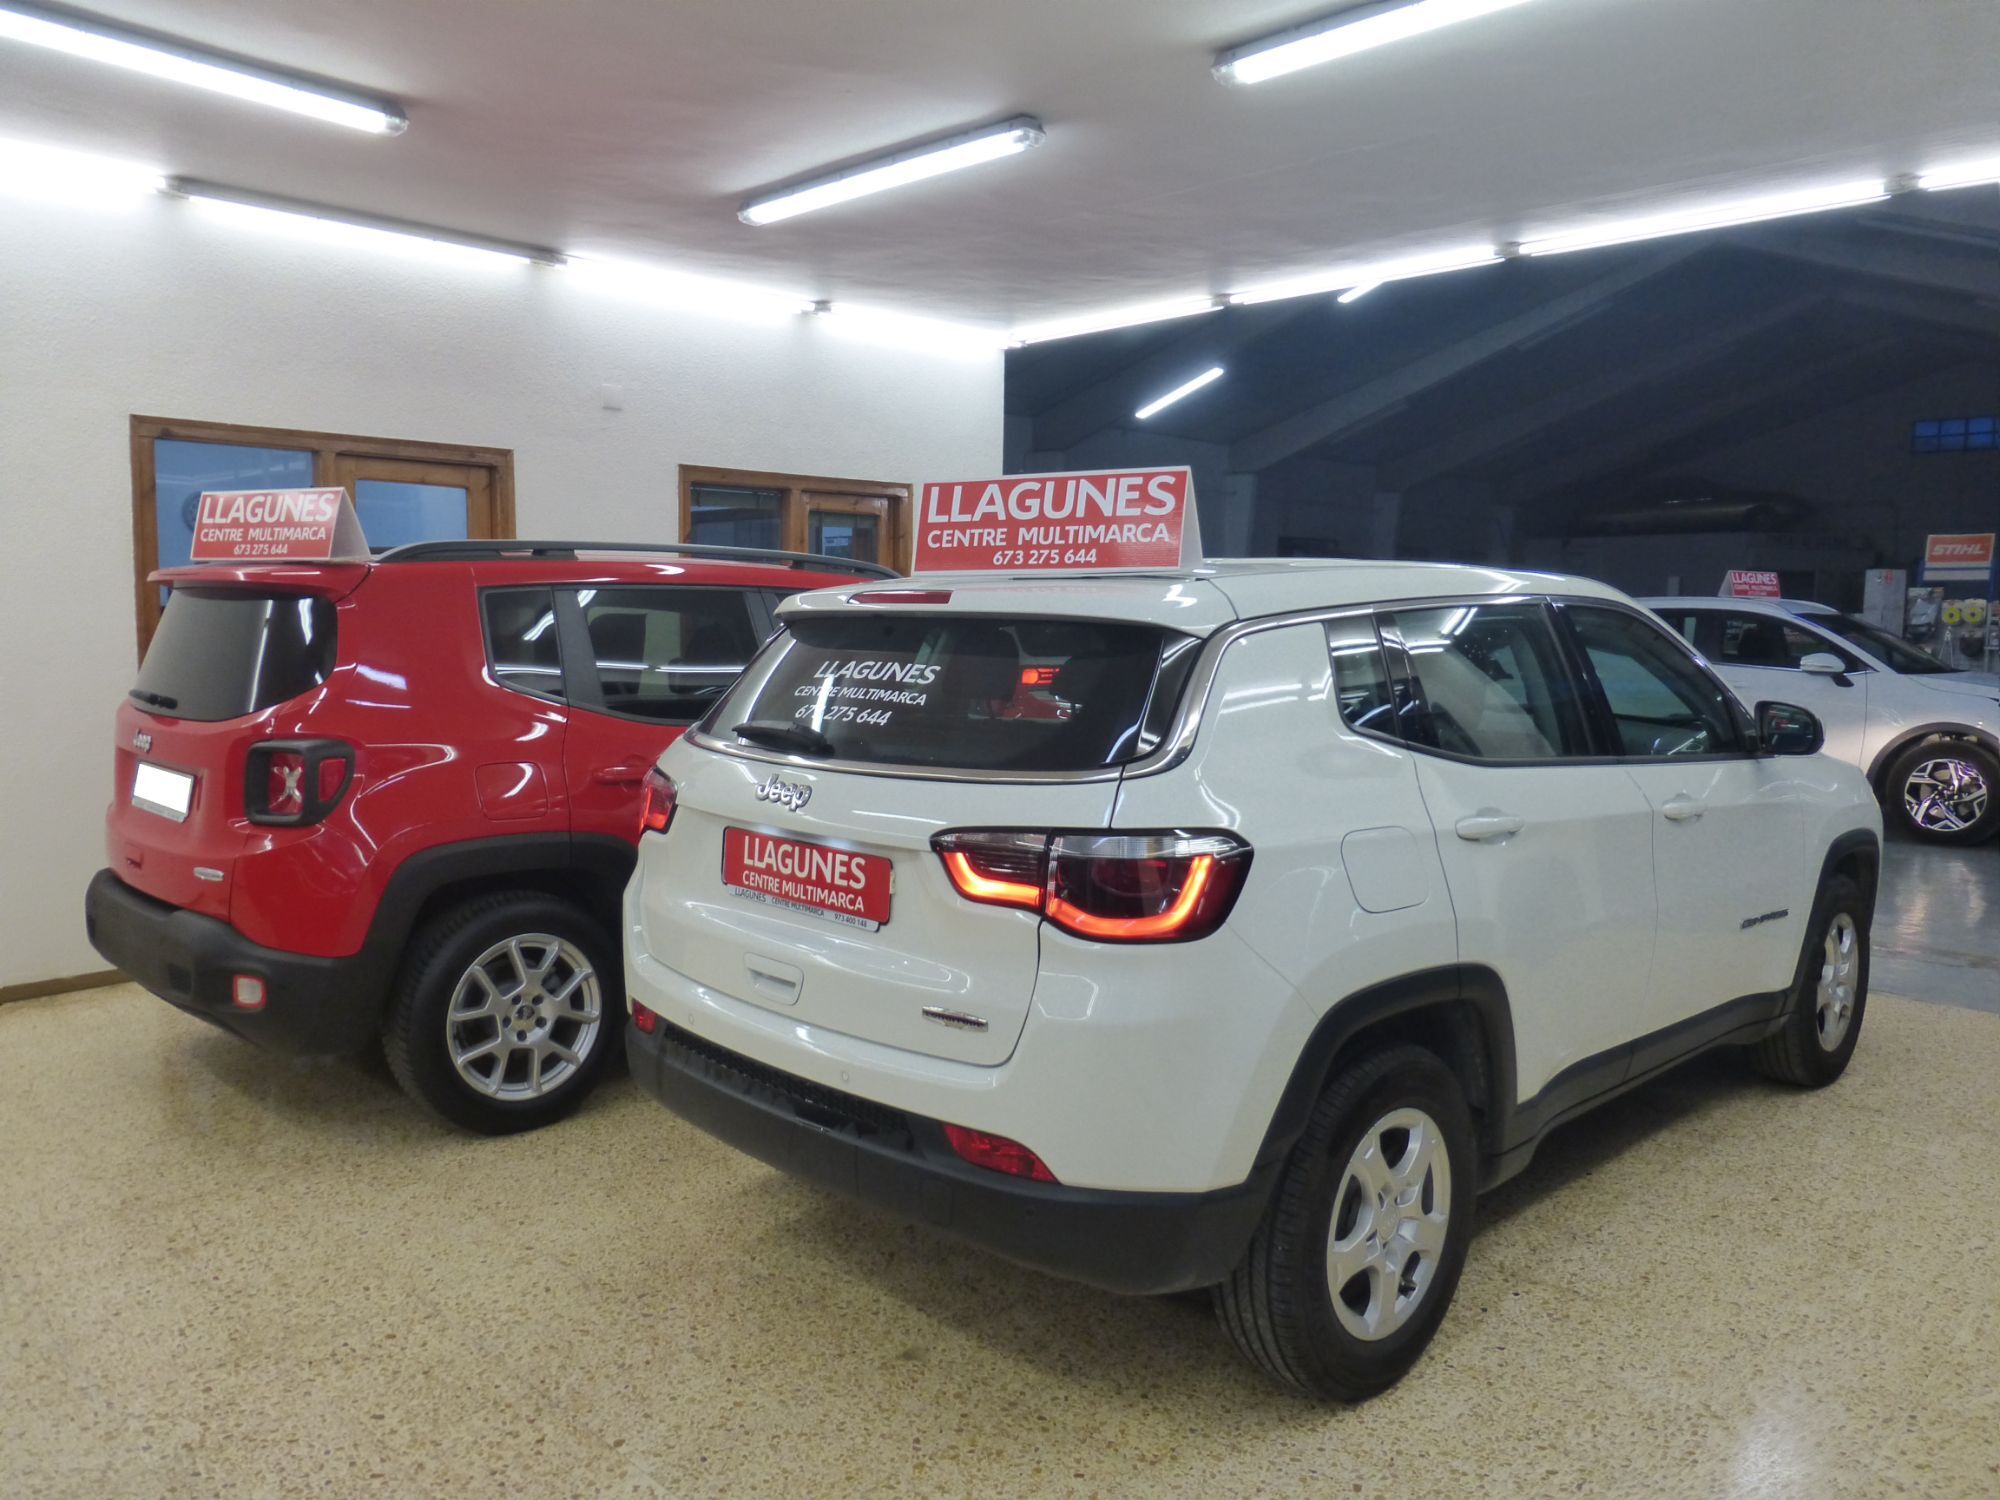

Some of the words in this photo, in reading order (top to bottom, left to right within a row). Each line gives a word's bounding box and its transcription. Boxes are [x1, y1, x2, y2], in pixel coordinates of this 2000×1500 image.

[202, 493, 335, 524] LLAGUNES
[927, 475, 1176, 524] LLAGUNES
[200, 528, 243, 542] CENTRE
[248, 527, 326, 542] MULTIMARCA
[927, 527, 1007, 549] CENTRE
[1018, 522, 1169, 546] MULTIMARCA
[233, 544, 250, 555] 673
[252, 543, 269, 555] 275
[270, 543, 288, 555] 644
[992, 550, 1024, 566] 673
[1029, 549, 1060, 565] 275
[1064, 548, 1097, 564] 644
[1931, 544, 1985, 556] STIHL
[1731, 572, 1777, 585] LLAGUNES
[814, 660, 942, 684] LLAGUNES
[838, 686, 927, 706] MULTIMARCA
[795, 704, 826, 718] 67
[823, 705, 858, 722] 275
[856, 708, 892, 726] 644
[756, 774, 813, 812] Jeep
[743, 835, 866, 890] LLAGUNES
[734, 886, 767, 903] LLAGUNES
[790, 900, 825, 917] MULTIMARCA
[742, 870, 781, 894] CENTRE
[782, 878, 865, 913] MULTIMARCA
